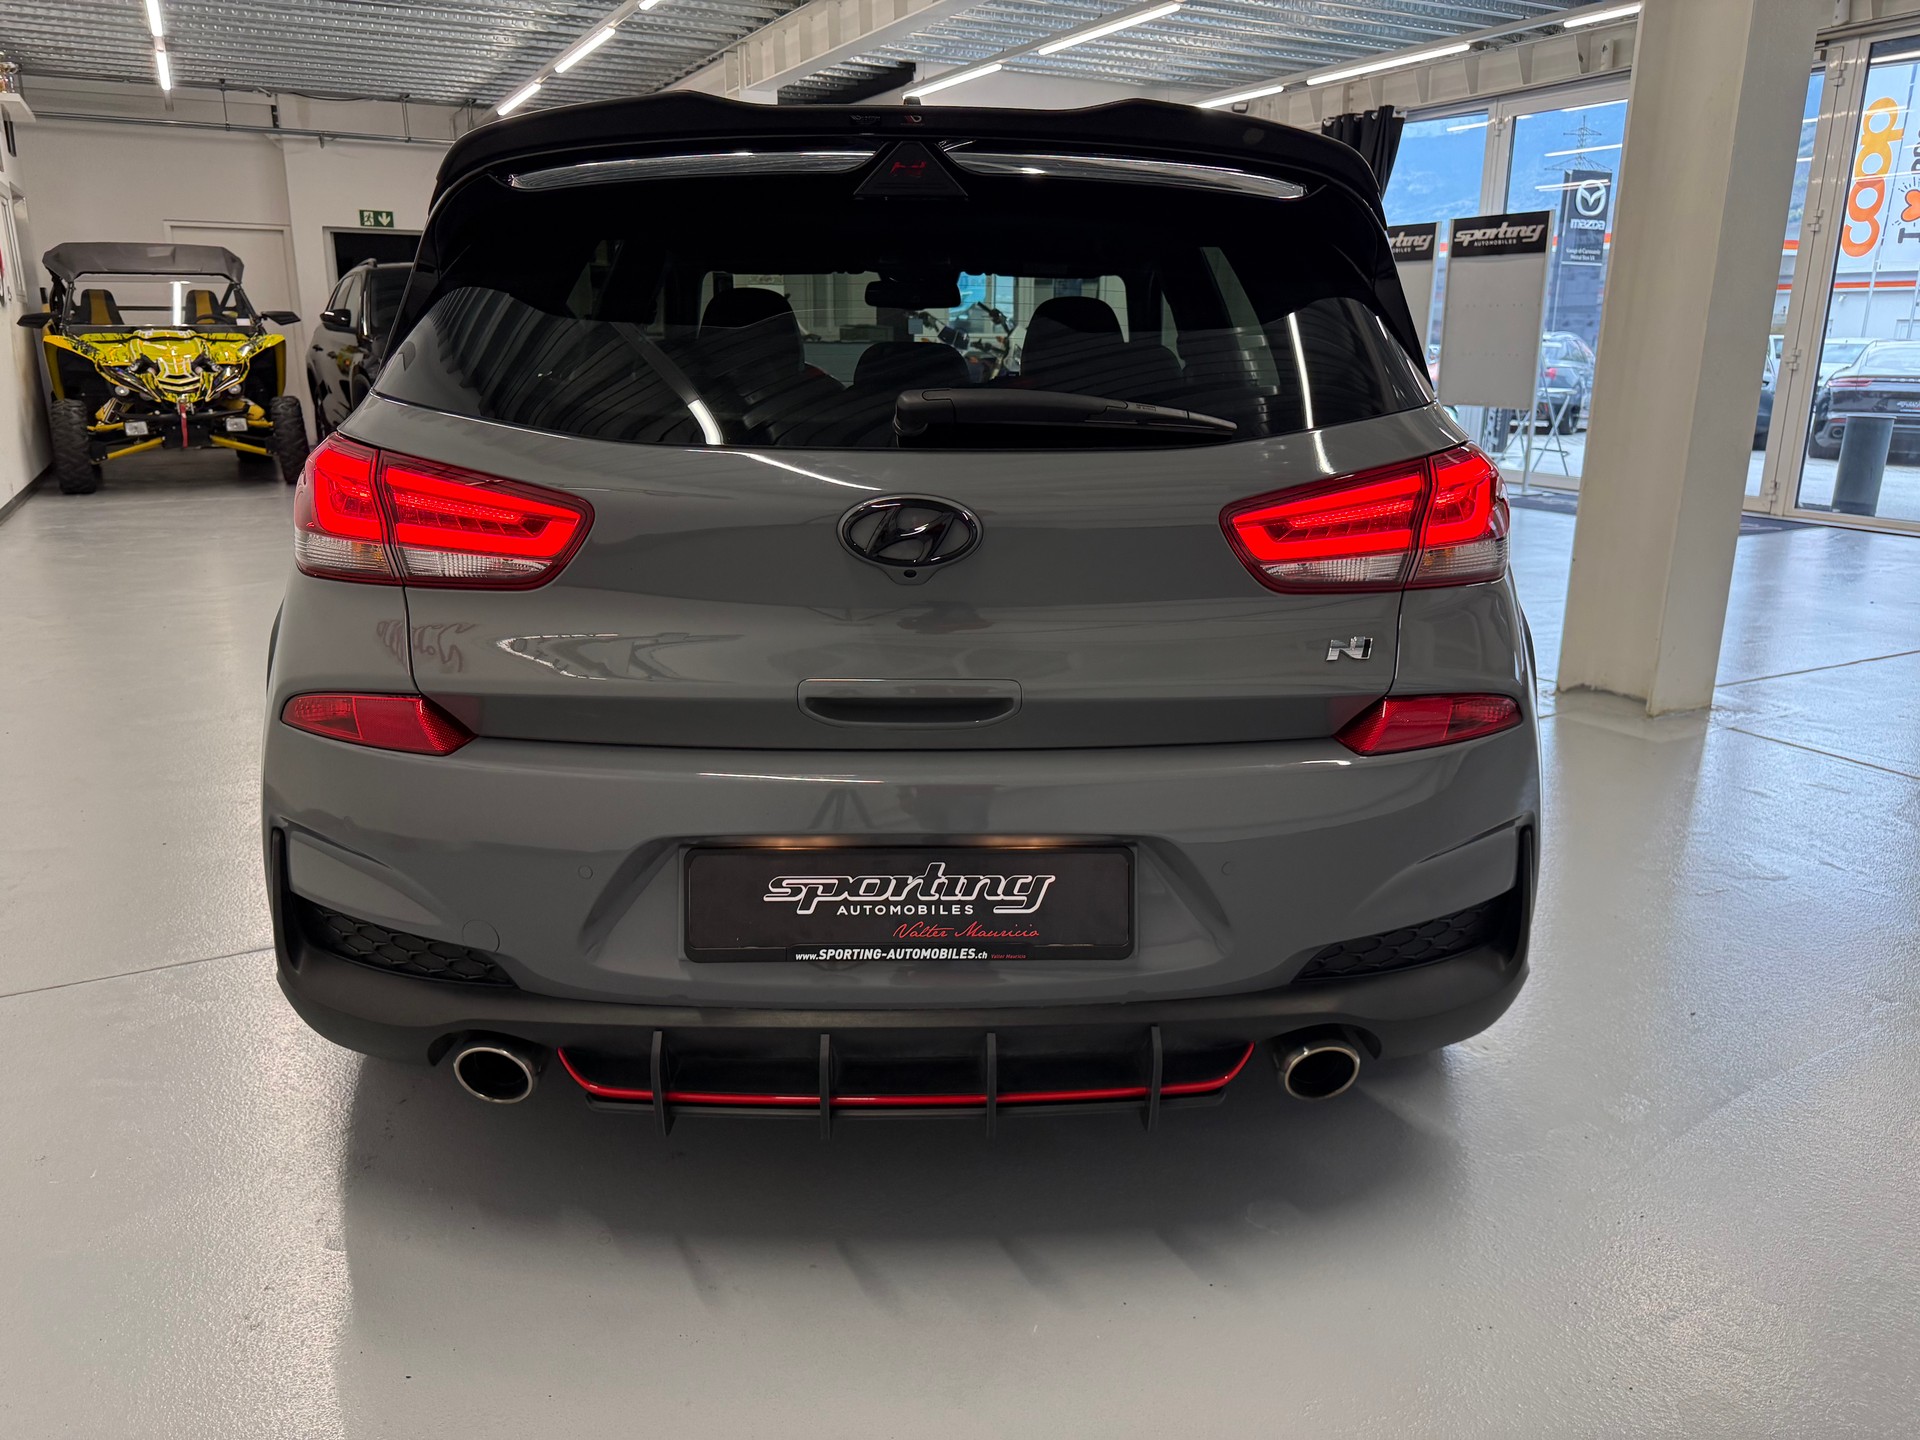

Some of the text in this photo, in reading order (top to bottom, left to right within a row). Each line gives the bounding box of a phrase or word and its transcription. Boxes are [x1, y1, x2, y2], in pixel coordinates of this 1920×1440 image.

[1841, 97, 1904, 257] coop
[1390, 231, 1433, 251] rting
[1454, 221, 1544, 247] sporting
[1473, 239, 1517, 247] AUTOMOBILES
[1326, 636, 1374, 661] N
[763, 862, 1056, 915] sporting
[836, 904, 975, 916] AUTOMOBILES
[893, 921, 1040, 939] Valter Mauricio
[795, 948, 988, 961] www.SPORTING-AUTOMOBILES.ch
